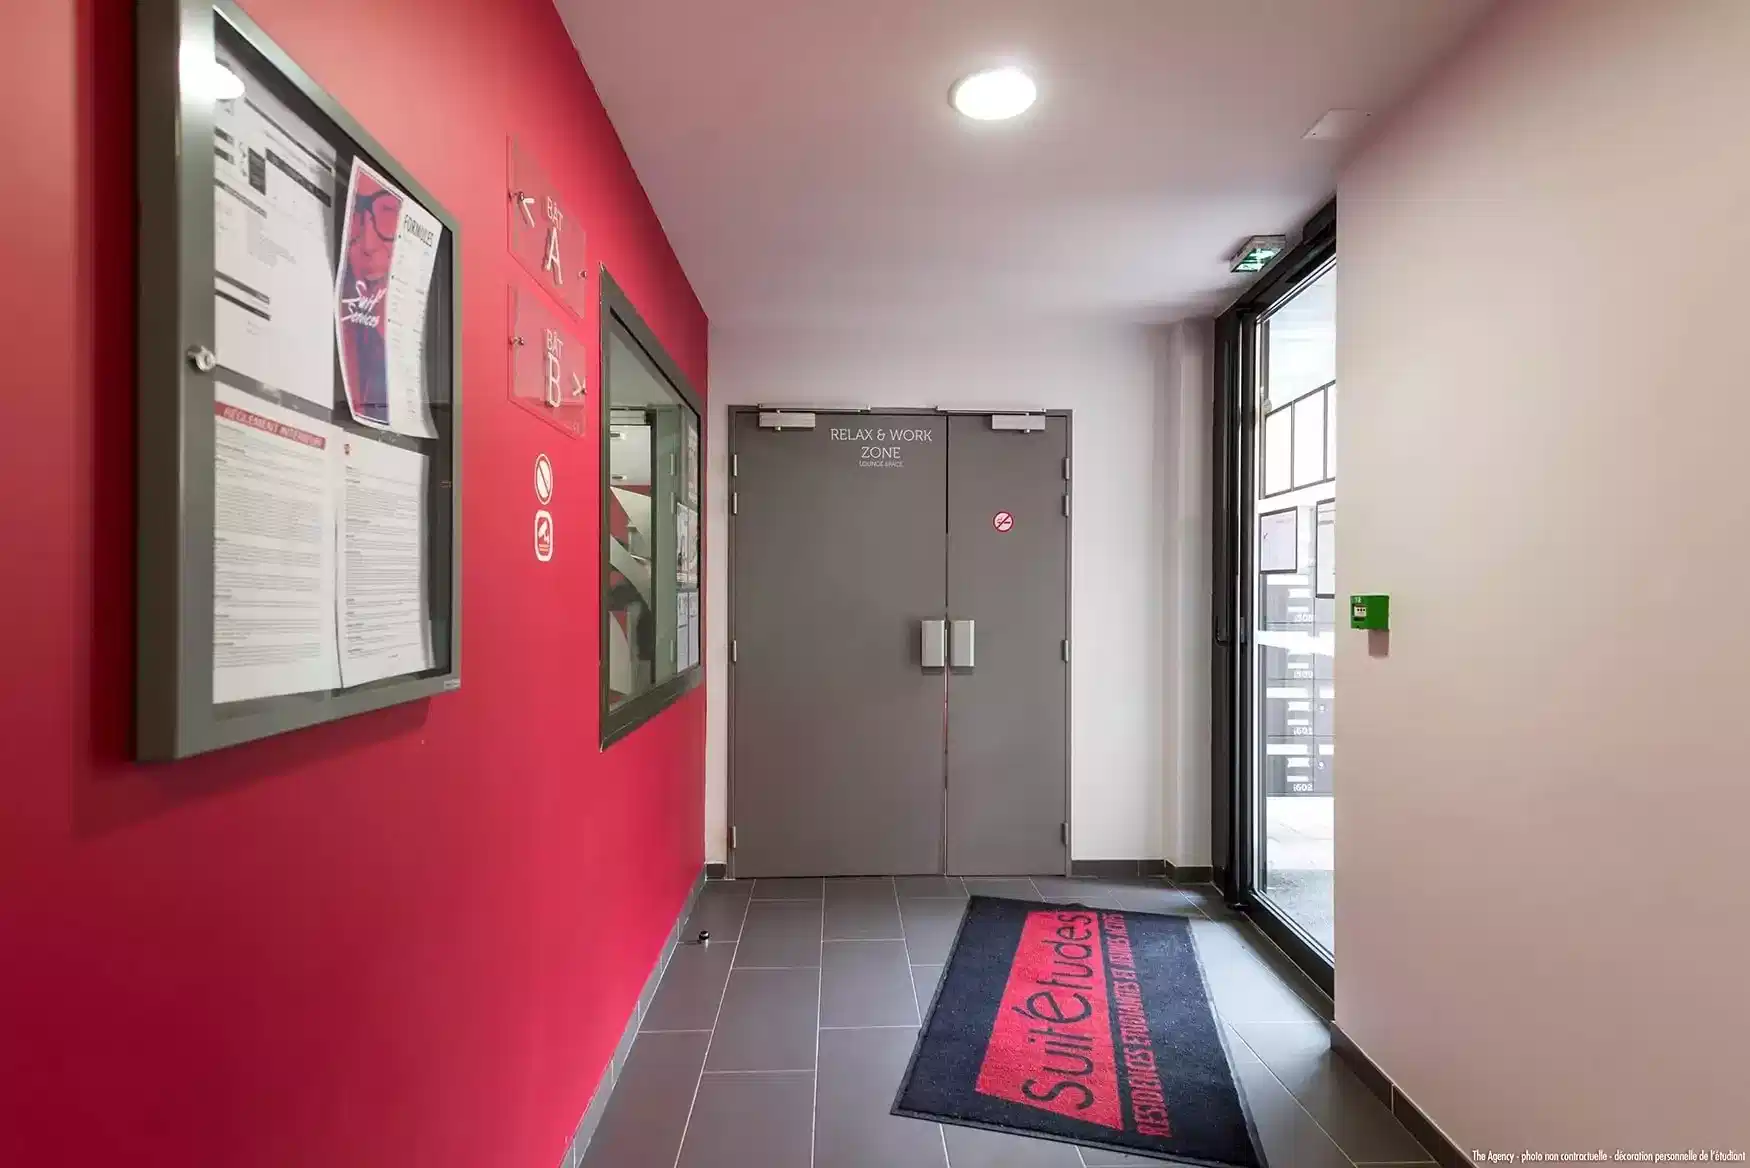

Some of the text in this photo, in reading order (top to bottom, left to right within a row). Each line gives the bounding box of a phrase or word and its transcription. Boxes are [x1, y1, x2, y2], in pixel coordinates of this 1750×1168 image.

[546, 227, 563, 284] A
[548, 351, 561, 408] B
[830, 428, 933, 442] RELAX & WORK
[861, 446, 901, 459] ZONE
